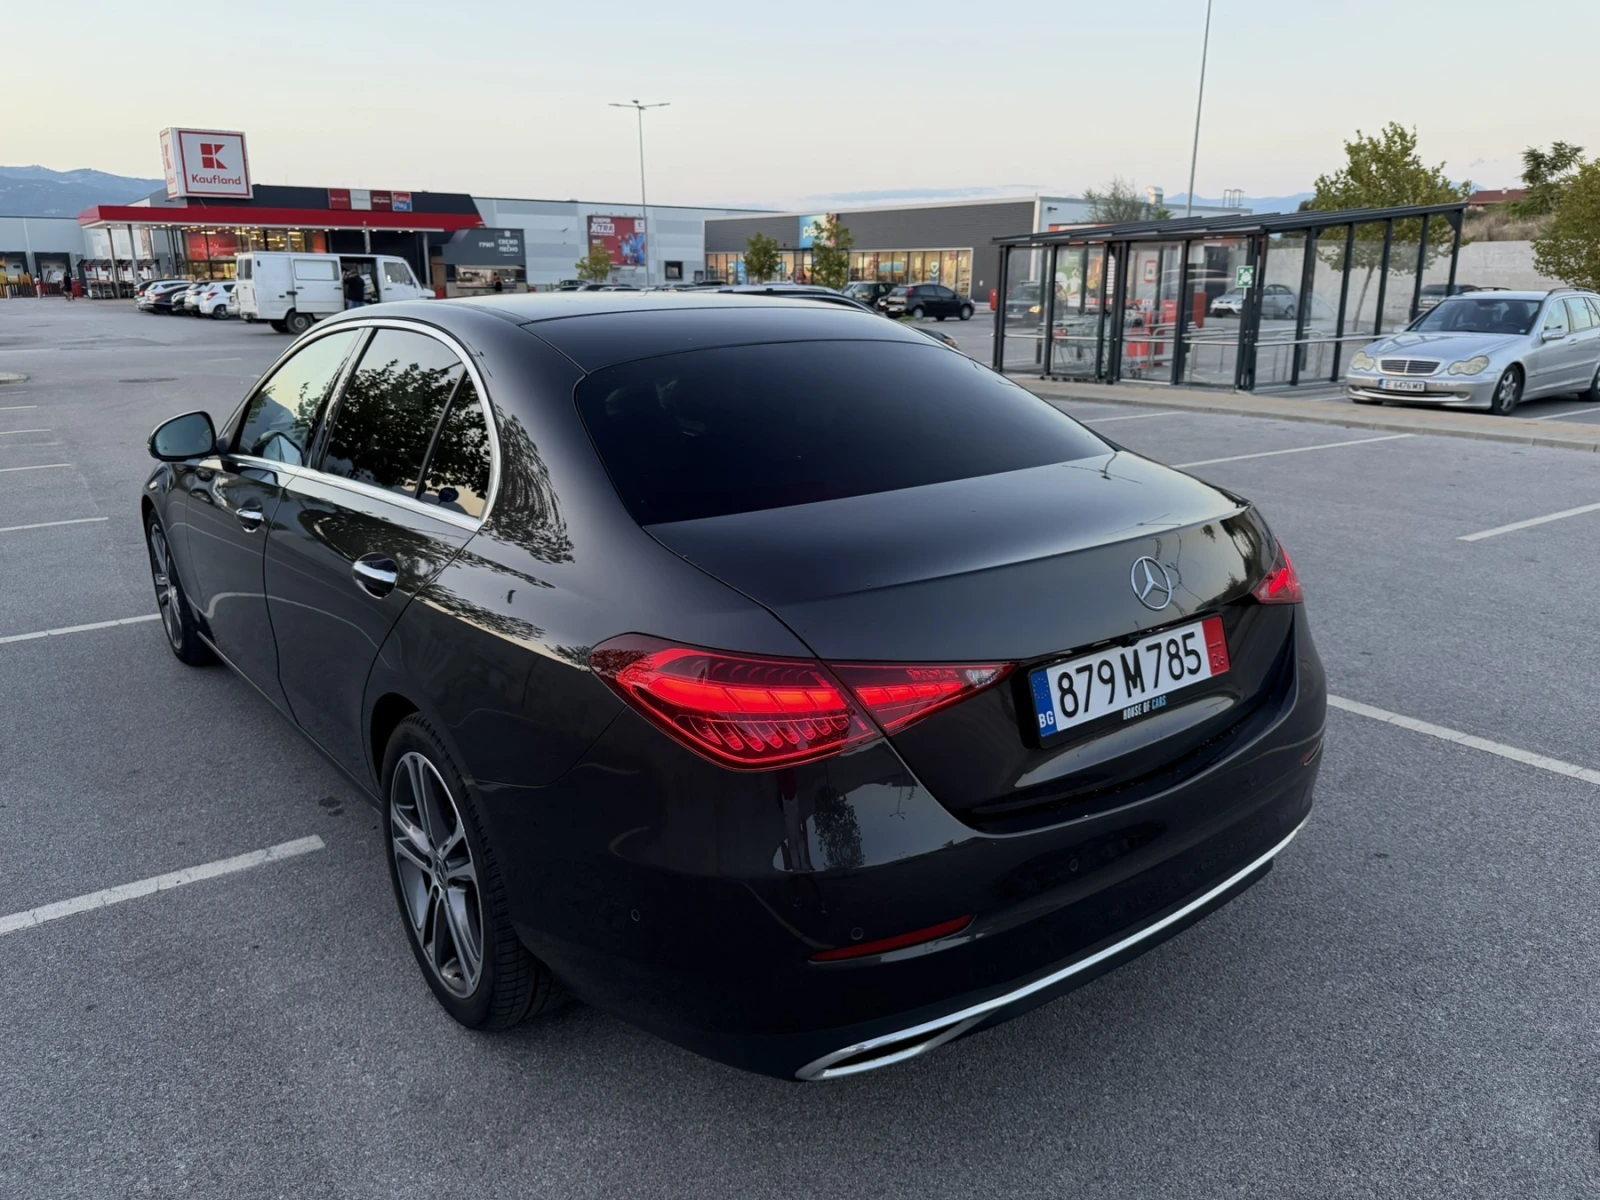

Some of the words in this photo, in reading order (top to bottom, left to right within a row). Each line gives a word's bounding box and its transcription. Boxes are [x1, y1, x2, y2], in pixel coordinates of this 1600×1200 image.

[200, 143, 228, 170] K
[191, 174, 241, 185] Kaufland
[1123, 703, 1142, 720] HOUSE
[1143, 700, 1151, 713] OF
[1151, 695, 1167, 710] CARS
[1038, 710, 1055, 729] BG
